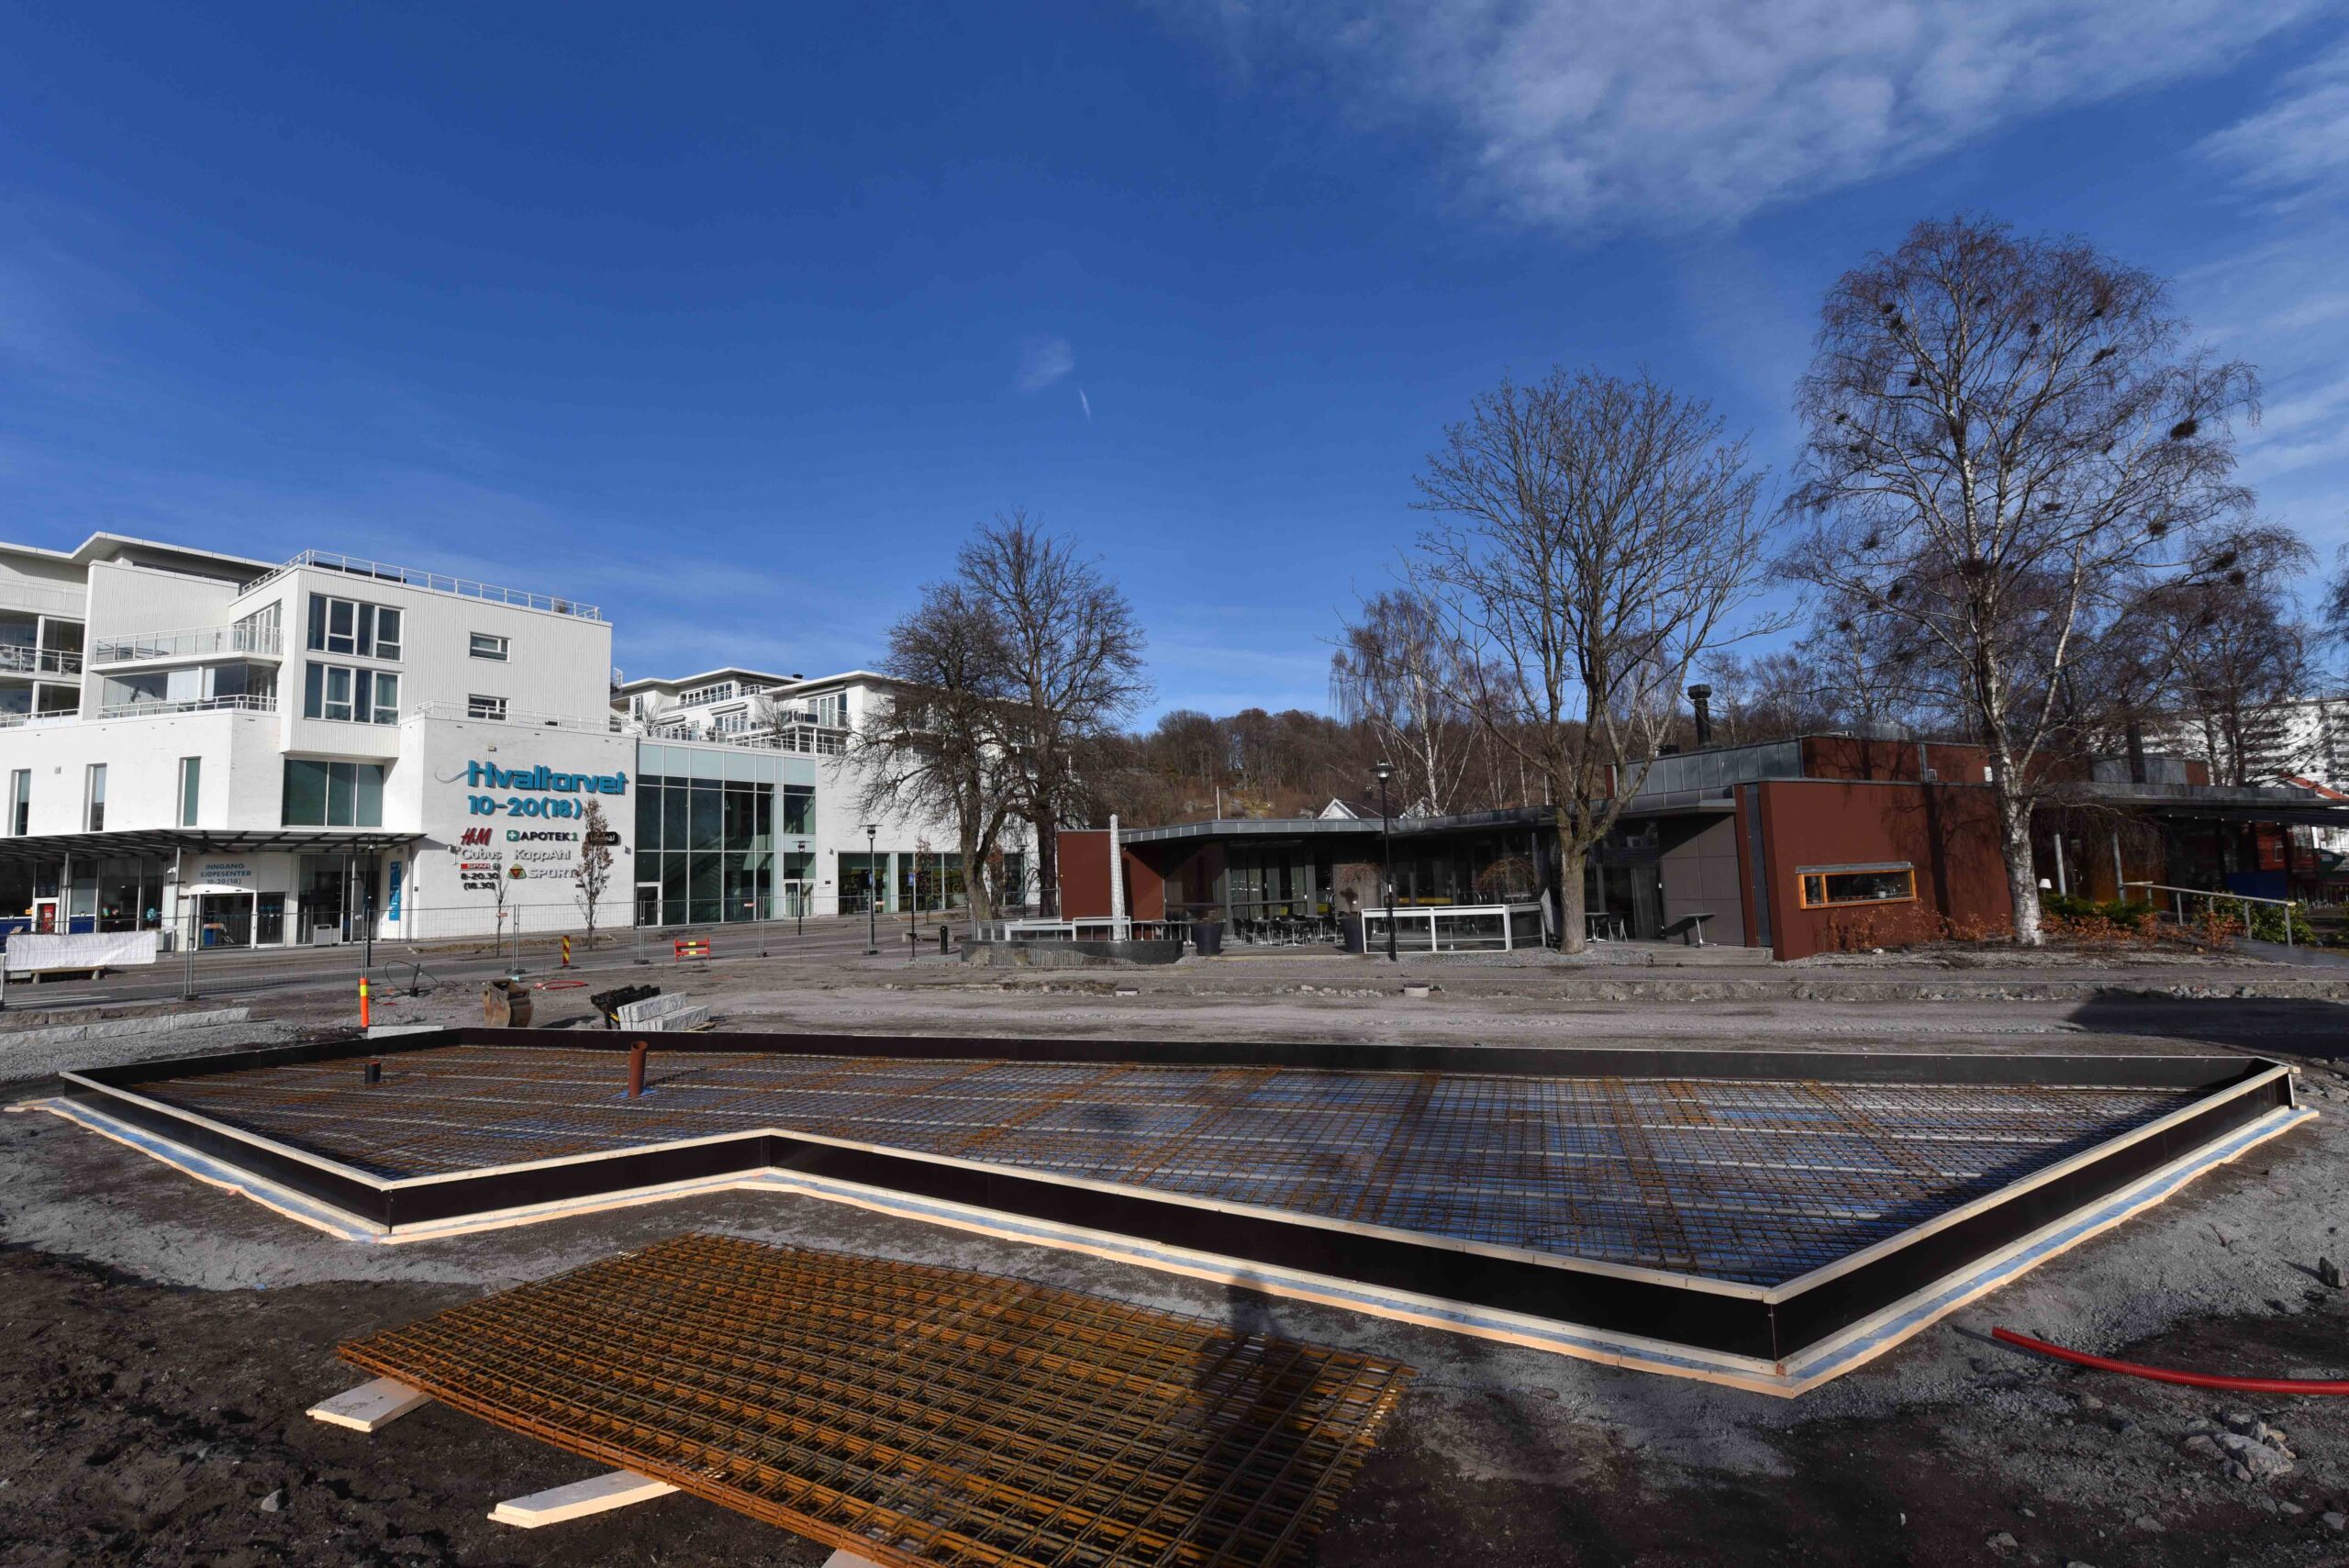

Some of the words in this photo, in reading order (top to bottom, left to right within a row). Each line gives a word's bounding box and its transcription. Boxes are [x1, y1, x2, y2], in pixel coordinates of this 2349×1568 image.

[468, 760, 629, 795] Hvaltorvet
[468, 795, 583, 819] 10-20(18)
[461, 828, 493, 846] H&M
[462, 849, 502, 860] Cubus
[515, 850, 572, 862] KappAhl
